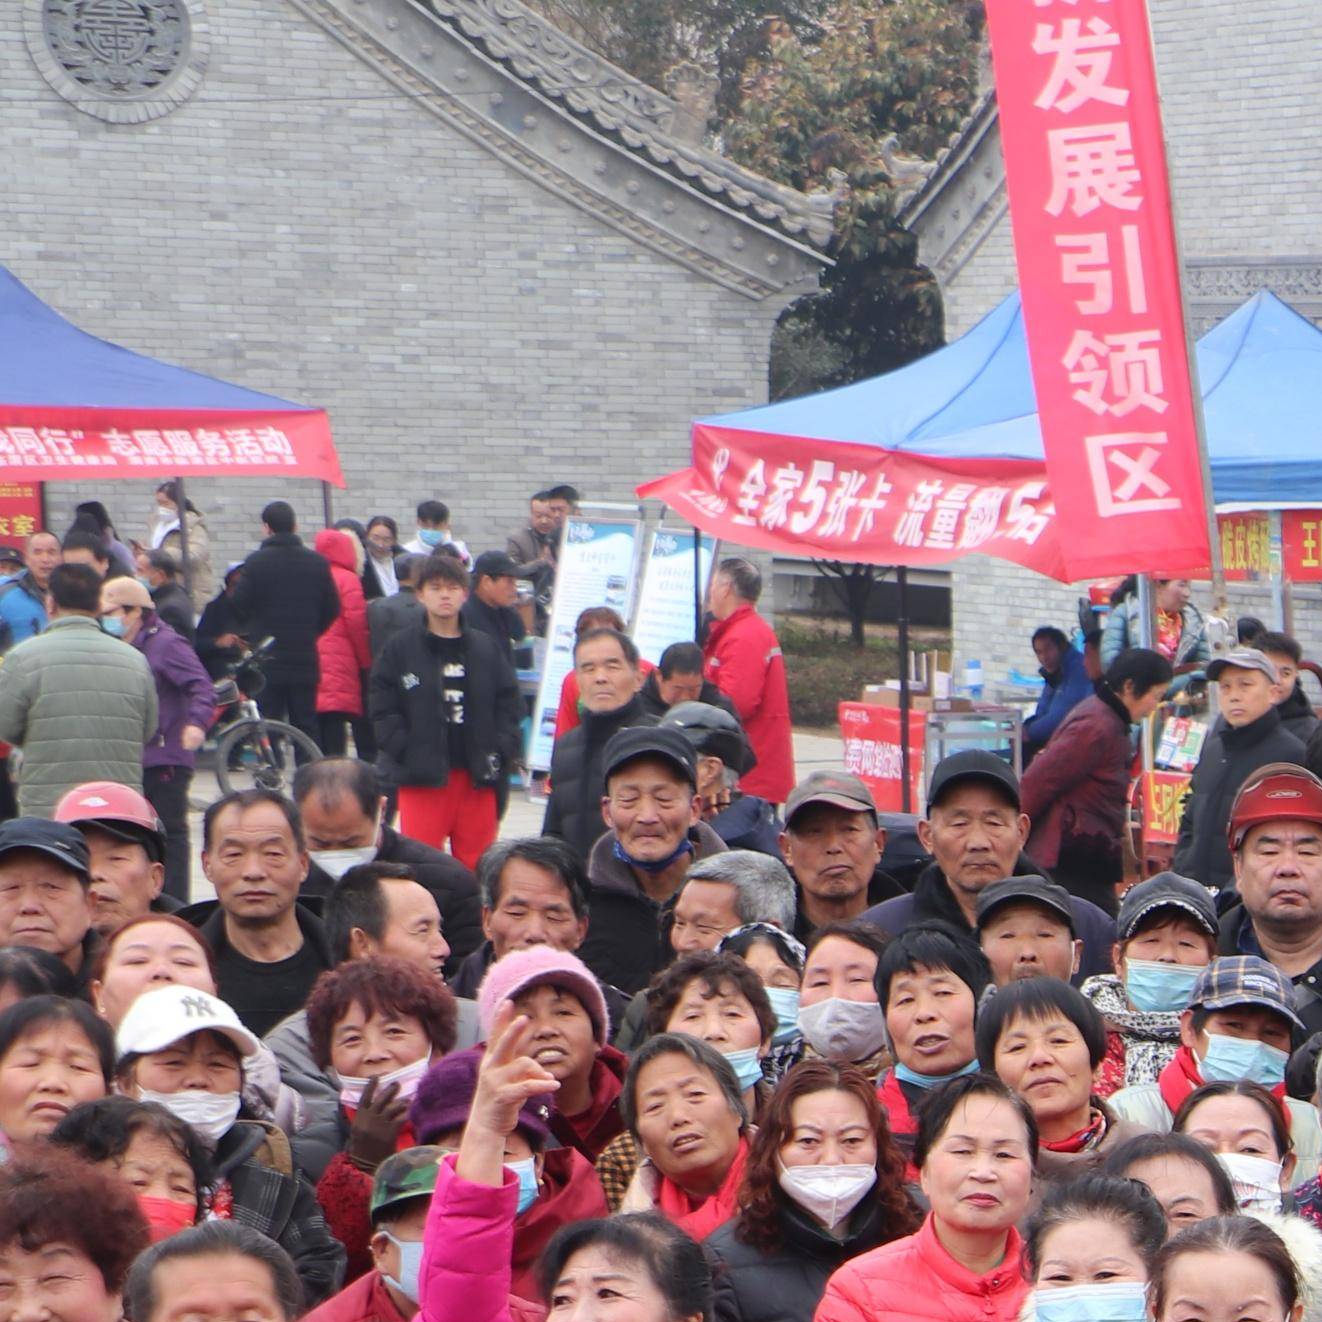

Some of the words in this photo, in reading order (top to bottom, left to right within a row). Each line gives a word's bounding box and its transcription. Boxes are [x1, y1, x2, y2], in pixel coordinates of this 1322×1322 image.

[1031, 0, 1181, 517] 发展引领区
[103, 427, 294, 457] 志愿服务活动
